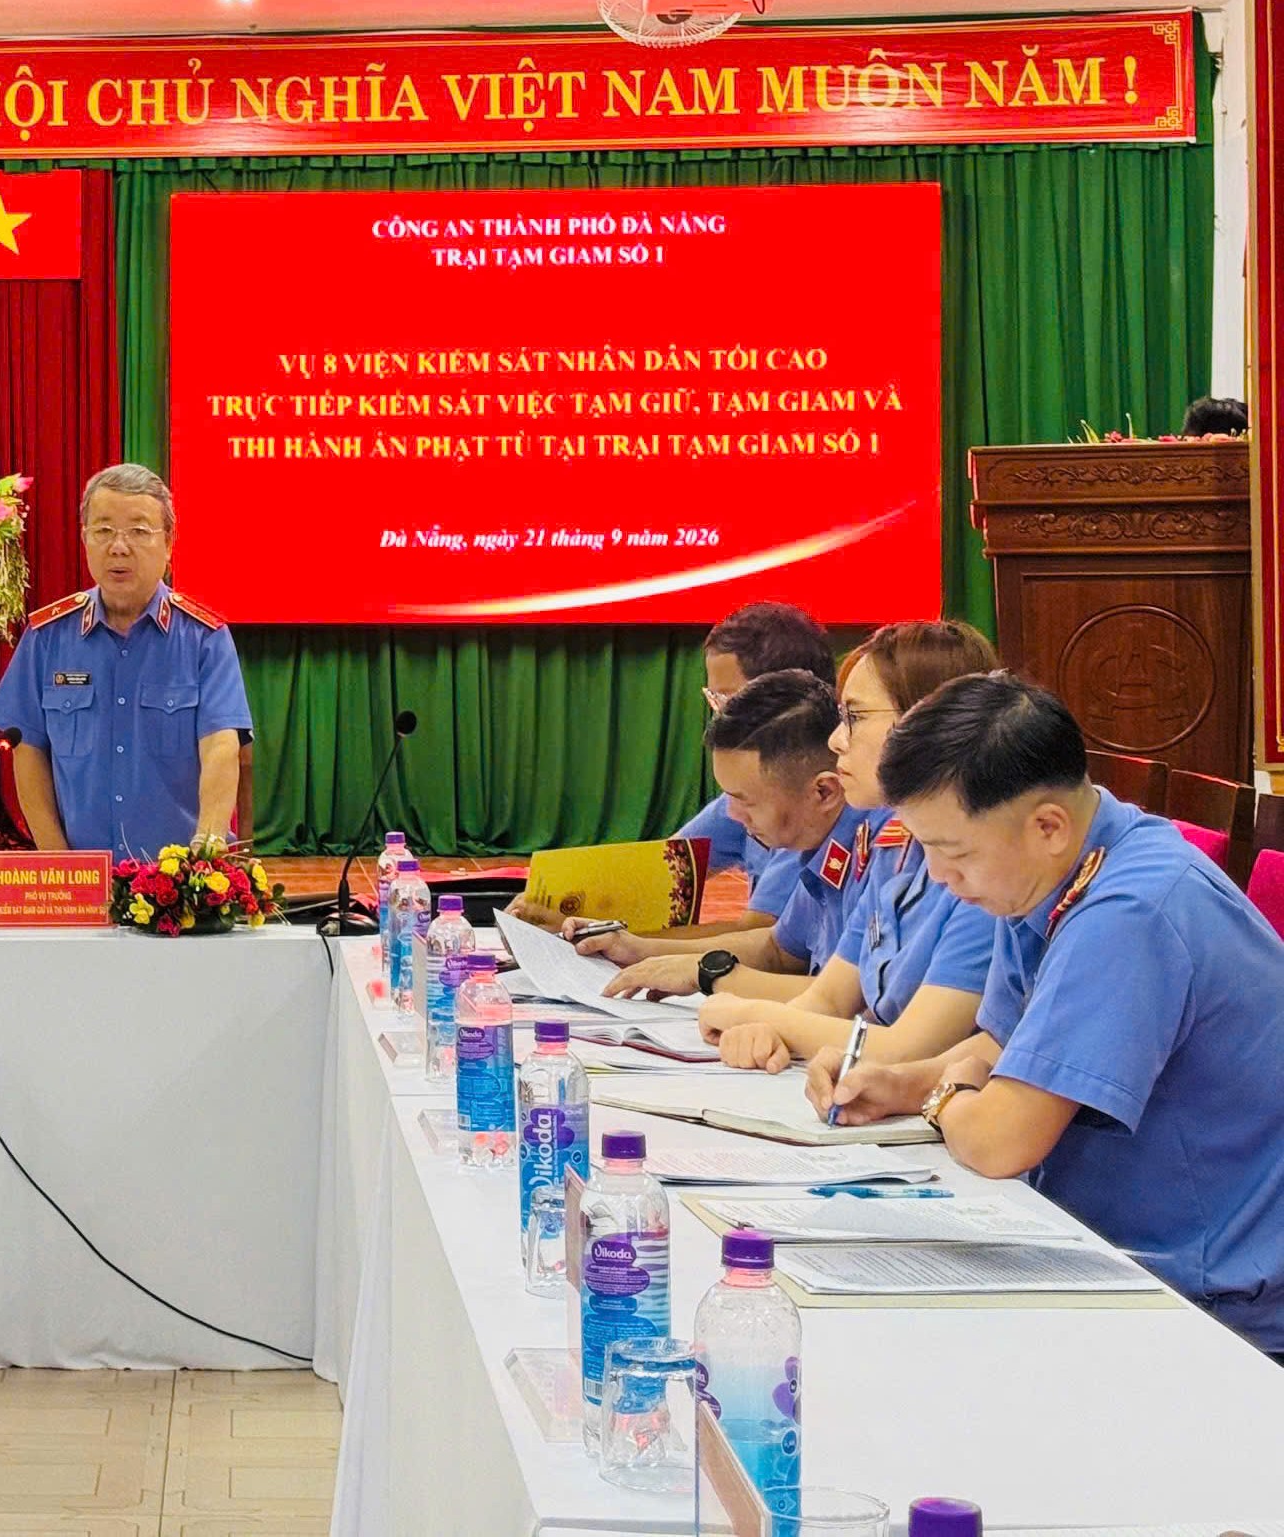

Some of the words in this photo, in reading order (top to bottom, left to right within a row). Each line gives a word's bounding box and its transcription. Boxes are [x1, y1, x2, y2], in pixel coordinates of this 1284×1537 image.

[88, 58, 213, 126] CHỦ
[231, 63, 429, 124] NGHĨA
[442, 58, 586, 132] VIỆT
[603, 68, 741, 117] NAM
[756, 47, 944, 115] MUÔN
[963, 44, 1107, 108] NĂM
[1123, 56, 1139, 104] !
[372, 216, 438, 237] CÔNG
[444, 220, 473, 236] AN
[433, 249, 485, 269] TRẠI
[495, 248, 542, 269] TẠM
[550, 247, 611, 264] GIAM
[654, 247, 663, 263] 1
[279, 355, 315, 379] VỤ
[324, 355, 336, 373] 8
[344, 351, 407, 378] VIỆN
[767, 349, 827, 369] CAO
[498, 394, 562, 418] VIỆC
[571, 393, 631, 417] TẠM
[708, 392, 768, 416] TẠM
[778, 391, 854, 411] GIAM
[228, 438, 274, 457] THI
[417, 437, 488, 461] PHẠT
[540, 436, 584, 460] TẠI
[594, 435, 658, 459] TRẠI
[668, 435, 729, 459] TẠM
[738, 434, 814, 453] GIAM
[869, 434, 879, 453] 1
[380, 531, 406, 547] Đà
[474, 530, 518, 550] ngày
[524, 529, 544, 546] 21
[552, 529, 604, 549] tháng
[612, 529, 622, 544] 9
[628, 530, 668, 545] năm
[675, 529, 719, 545] 2026
[41, 868, 64, 884] VĂN
[68, 870, 99, 884] LONG
[594, 1244, 634, 1260] Vikoda
